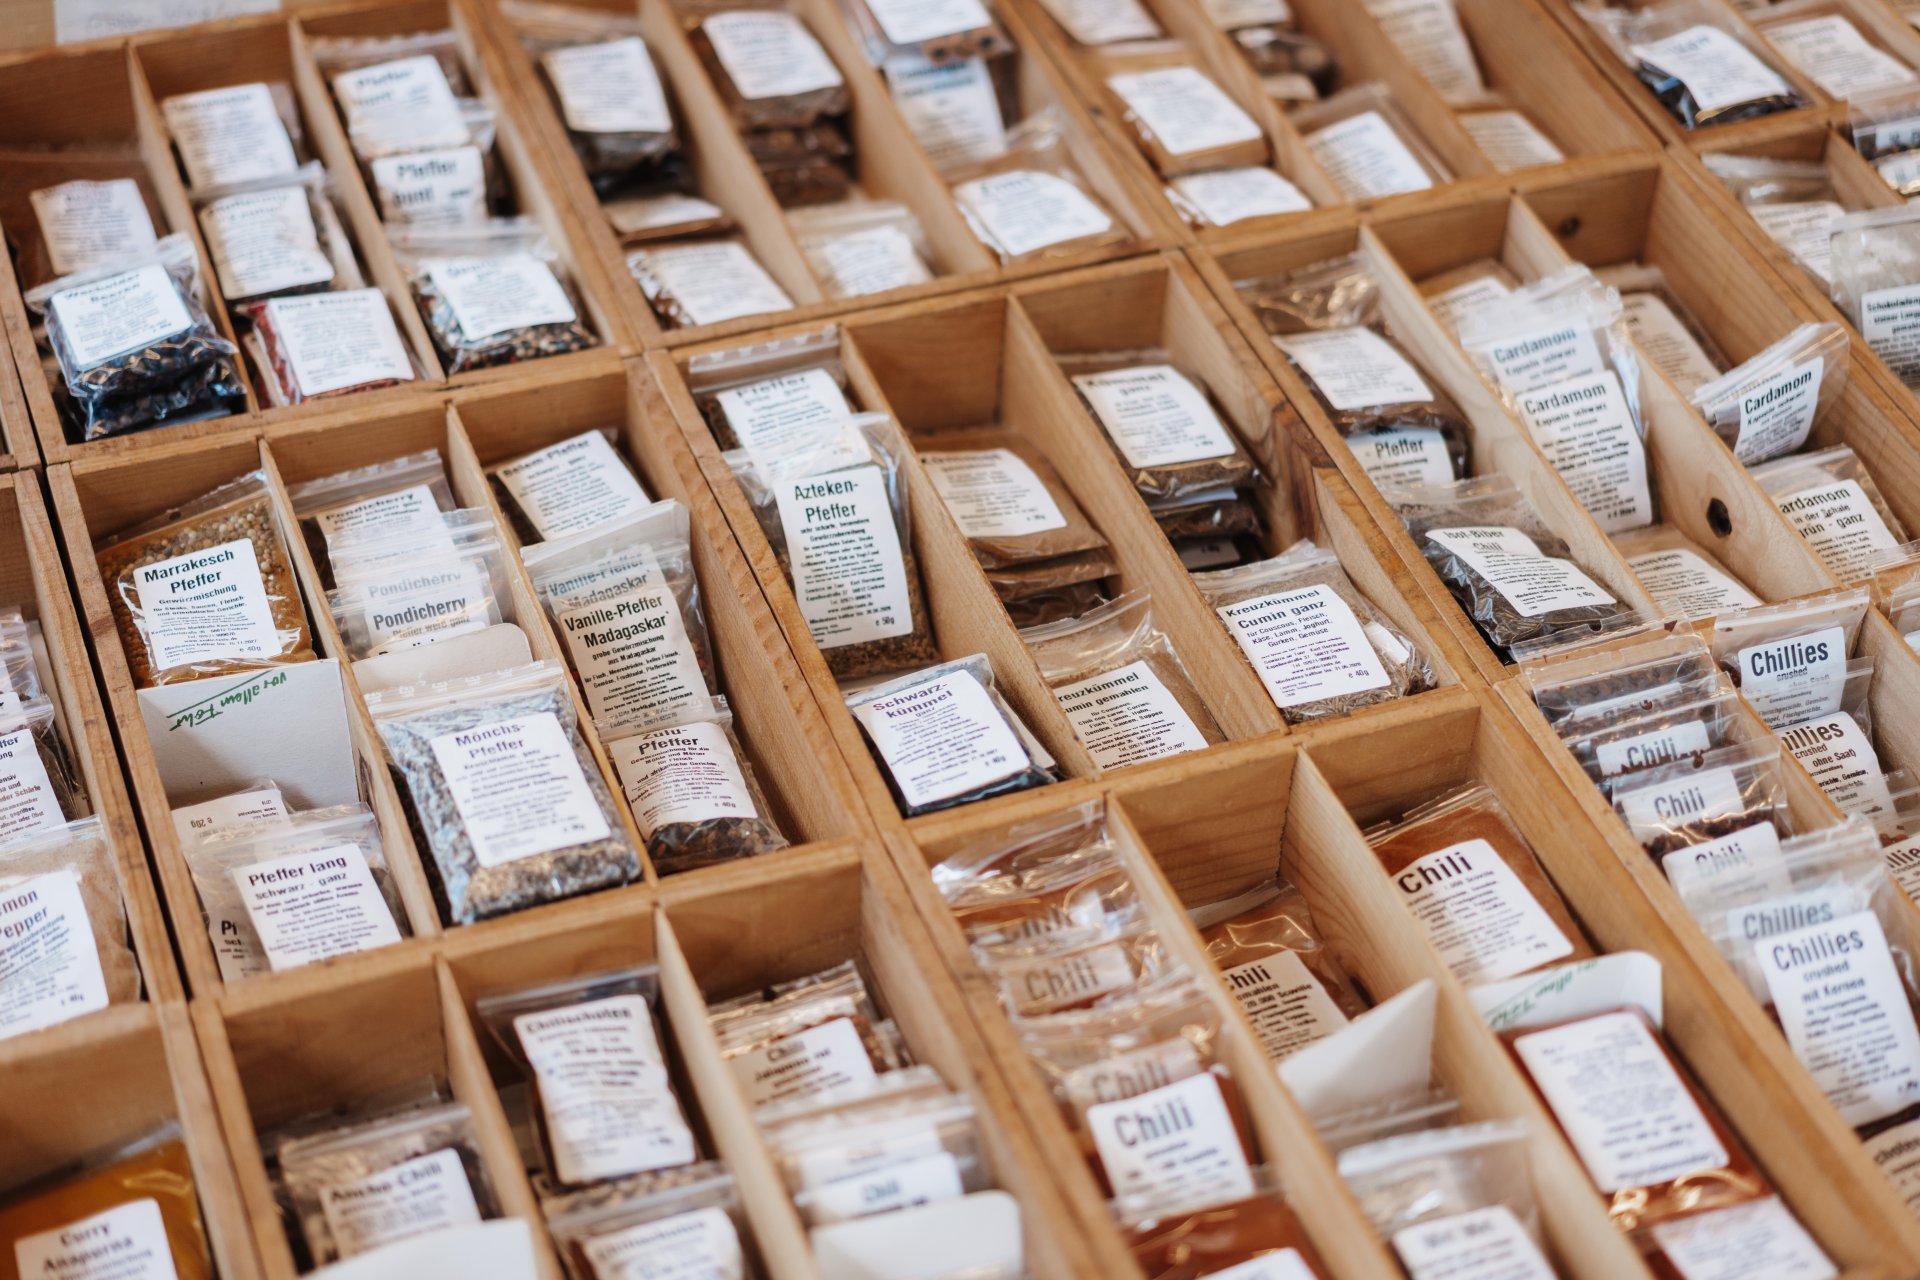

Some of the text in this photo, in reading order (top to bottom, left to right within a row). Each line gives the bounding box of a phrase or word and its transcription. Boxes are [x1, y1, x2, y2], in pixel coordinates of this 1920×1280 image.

[1493, 327, 1577, 364] Cardamom
[1524, 383, 1607, 415] Cardamom
[1745, 370, 1812, 415] Cardamom
[793, 479, 860, 502] Azteken-
[1778, 487, 1851, 515] ardamom
[804, 502, 858, 524] Pfeffer
[1836, 513, 1866, 529] ganz
[143, 549, 236, 584] Marrakesch
[157, 583, 238, 606] Gewürzmischung
[169, 569, 223, 595] Pfeffer
[372, 596, 467, 631] Pondicherry
[564, 595, 665, 633] Vanille-Pfeffer
[1225, 589, 1321, 618] Kreuzkümmel
[1237, 600, 1328, 631] Cumin ganz
[1246, 611, 1329, 639] für Couscous, Fleisch,
[1251, 634, 1274, 645] Käse,
[1274, 626, 1302, 639] Lamm,
[1267, 627, 1329, 648] Gurken, Gemüse
[592, 633, 665, 662] grobe Gewürzmischung
[620, 645, 657, 662] Madagaskar
[1750, 641, 1830, 678] Chillies
[1057, 671, 1140, 703] reuzkümmel
[1354, 668, 1371, 679] 40g
[1776, 666, 1809, 682] crushed
[872, 682, 949, 712] Schwarz-
[886, 690, 954, 720] kümmel
[1063, 684, 1150, 715] umin gemahlen
[454, 722, 527, 748] Mönchs-
[468, 737, 525, 760] Pfeffer
[638, 737, 699, 756] Pfeffer
[641, 727, 688, 741] Zulu-
[1626, 736, 1679, 770] Chili
[1794, 743, 1829, 760] crushed
[1812, 756, 1835, 768] ohne
[1653, 786, 1707, 821] Chili
[248, 855, 348, 887] Pfeffer lang
[255, 871, 348, 901] schwarz ganz
[1397, 850, 1473, 895] Chili
[1743, 901, 1835, 940] Chillies
[1772, 929, 1864, 971] Chillies
[1024, 956, 1099, 1003] Chili
[1114, 1097, 1195, 1149] Chili
